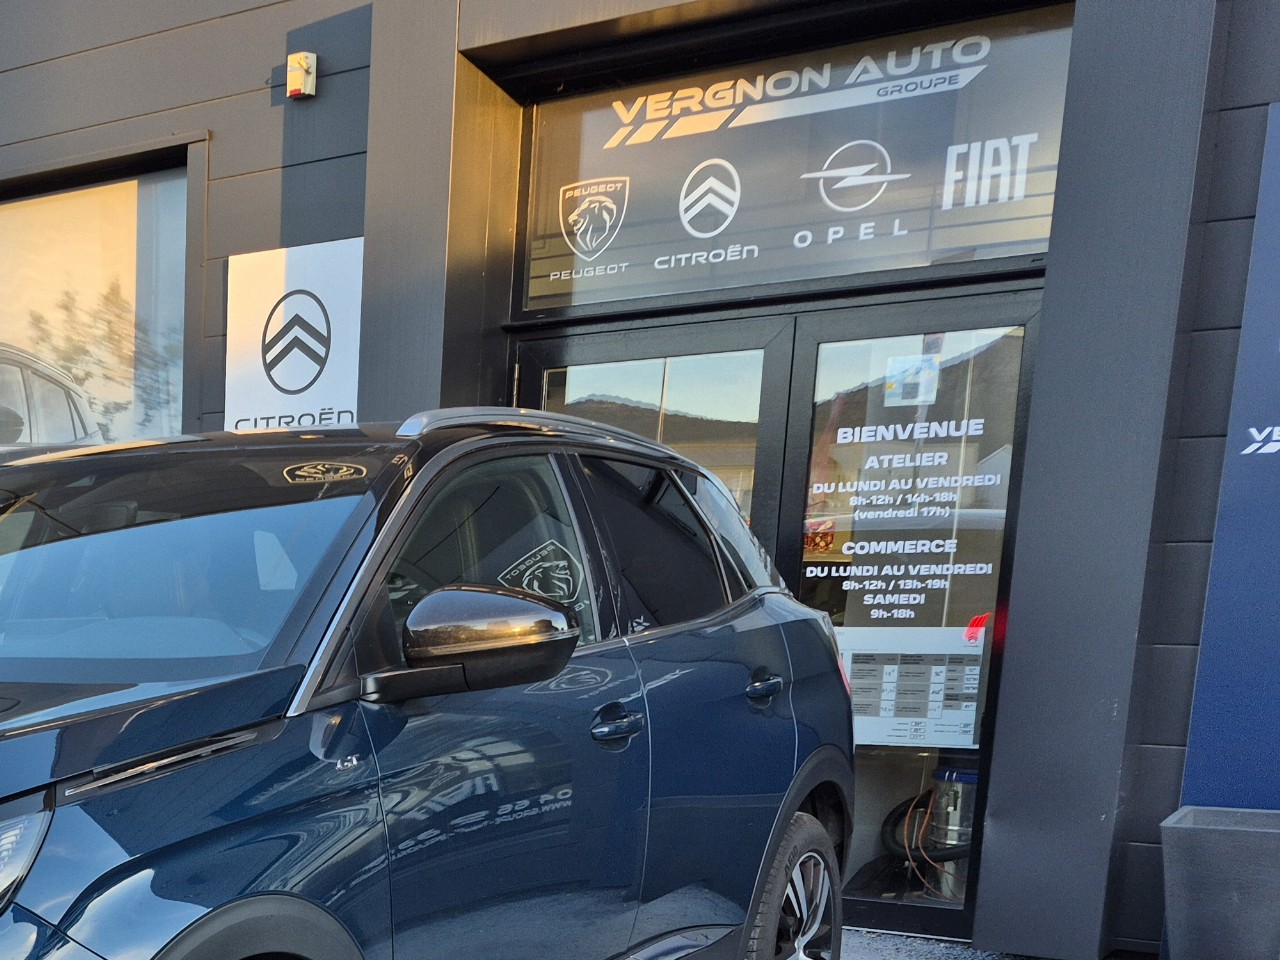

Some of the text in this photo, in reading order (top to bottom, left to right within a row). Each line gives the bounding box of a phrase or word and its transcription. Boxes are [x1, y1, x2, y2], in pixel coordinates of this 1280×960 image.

[611, 35, 992, 126] VERGNON AUTO
[876, 74, 960, 98] GROUPE
[941, 132, 1039, 211] FIAT
[565, 182, 623, 199] PEUGEOT
[792, 217, 908, 250] OPEL
[654, 244, 759, 269] CITROËN
[549, 262, 629, 281] PEUGEOT
[836, 418, 985, 444] BIENVENUE
[865, 452, 948, 469] ATELIER
[813, 474, 1001, 494] DU LUNDI AU VENDREDI
[849, 494, 894, 506] 8h-12h
[905, 491, 959, 504] 14h-18h
[854, 506, 950, 521] (vendredi 17h)
[842, 539, 957, 555] COMMERCE
[806, 563, 993, 577] DU LUNDI AU VENDREDI
[842, 580, 886, 591] 8h-12h
[897, 578, 950, 590] 13h-19h
[863, 593, 926, 605] SAMEDI
[870, 608, 915, 619] 9h-18h
